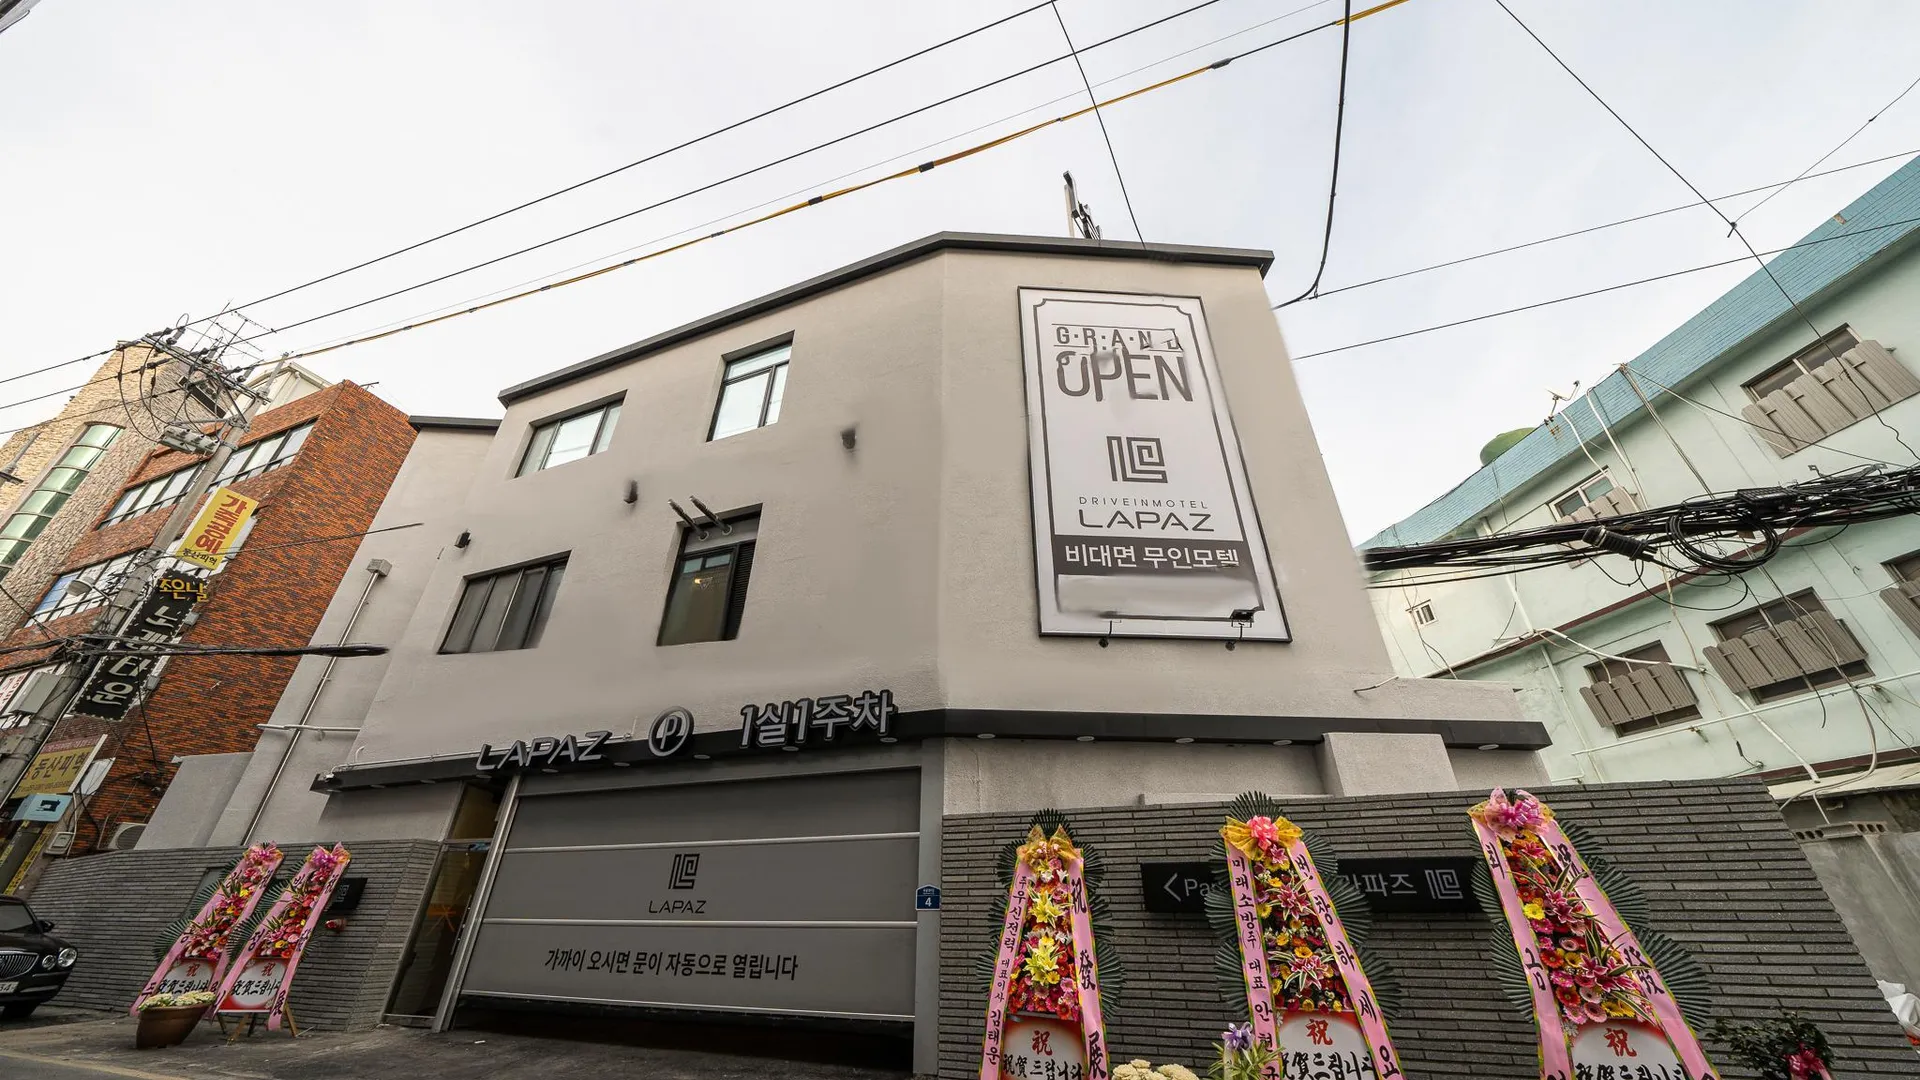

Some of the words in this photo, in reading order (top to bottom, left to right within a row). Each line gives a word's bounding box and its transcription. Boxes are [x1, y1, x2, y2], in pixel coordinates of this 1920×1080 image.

[1078, 509, 1215, 532] LAPAZ
[1065, 543, 1137, 568] 비대면
[1143, 546, 1240, 570] 무인모텔
[159, 578, 210, 602] 조은날
[476, 730, 613, 771] LAPAZ
[648, 900, 707, 914] LAPAZ
[925, 897, 932, 907] 4
[544, 948, 587, 972] 가까이
[586, 950, 631, 974] 오시면
[632, 951, 663, 976] 문이
[665, 952, 727, 977] 자동으로
[732, 953, 799, 981] 열립니다
[1248, 959, 1267, 990] 대표
[994, 959, 1010, 1004] 대표이사
[985, 1009, 1001, 1067] 김태운
[1032, 1030, 1053, 1056] 祝
[1305, 1018, 1334, 1046] 祝
[1603, 1027, 1638, 1058] 祝
